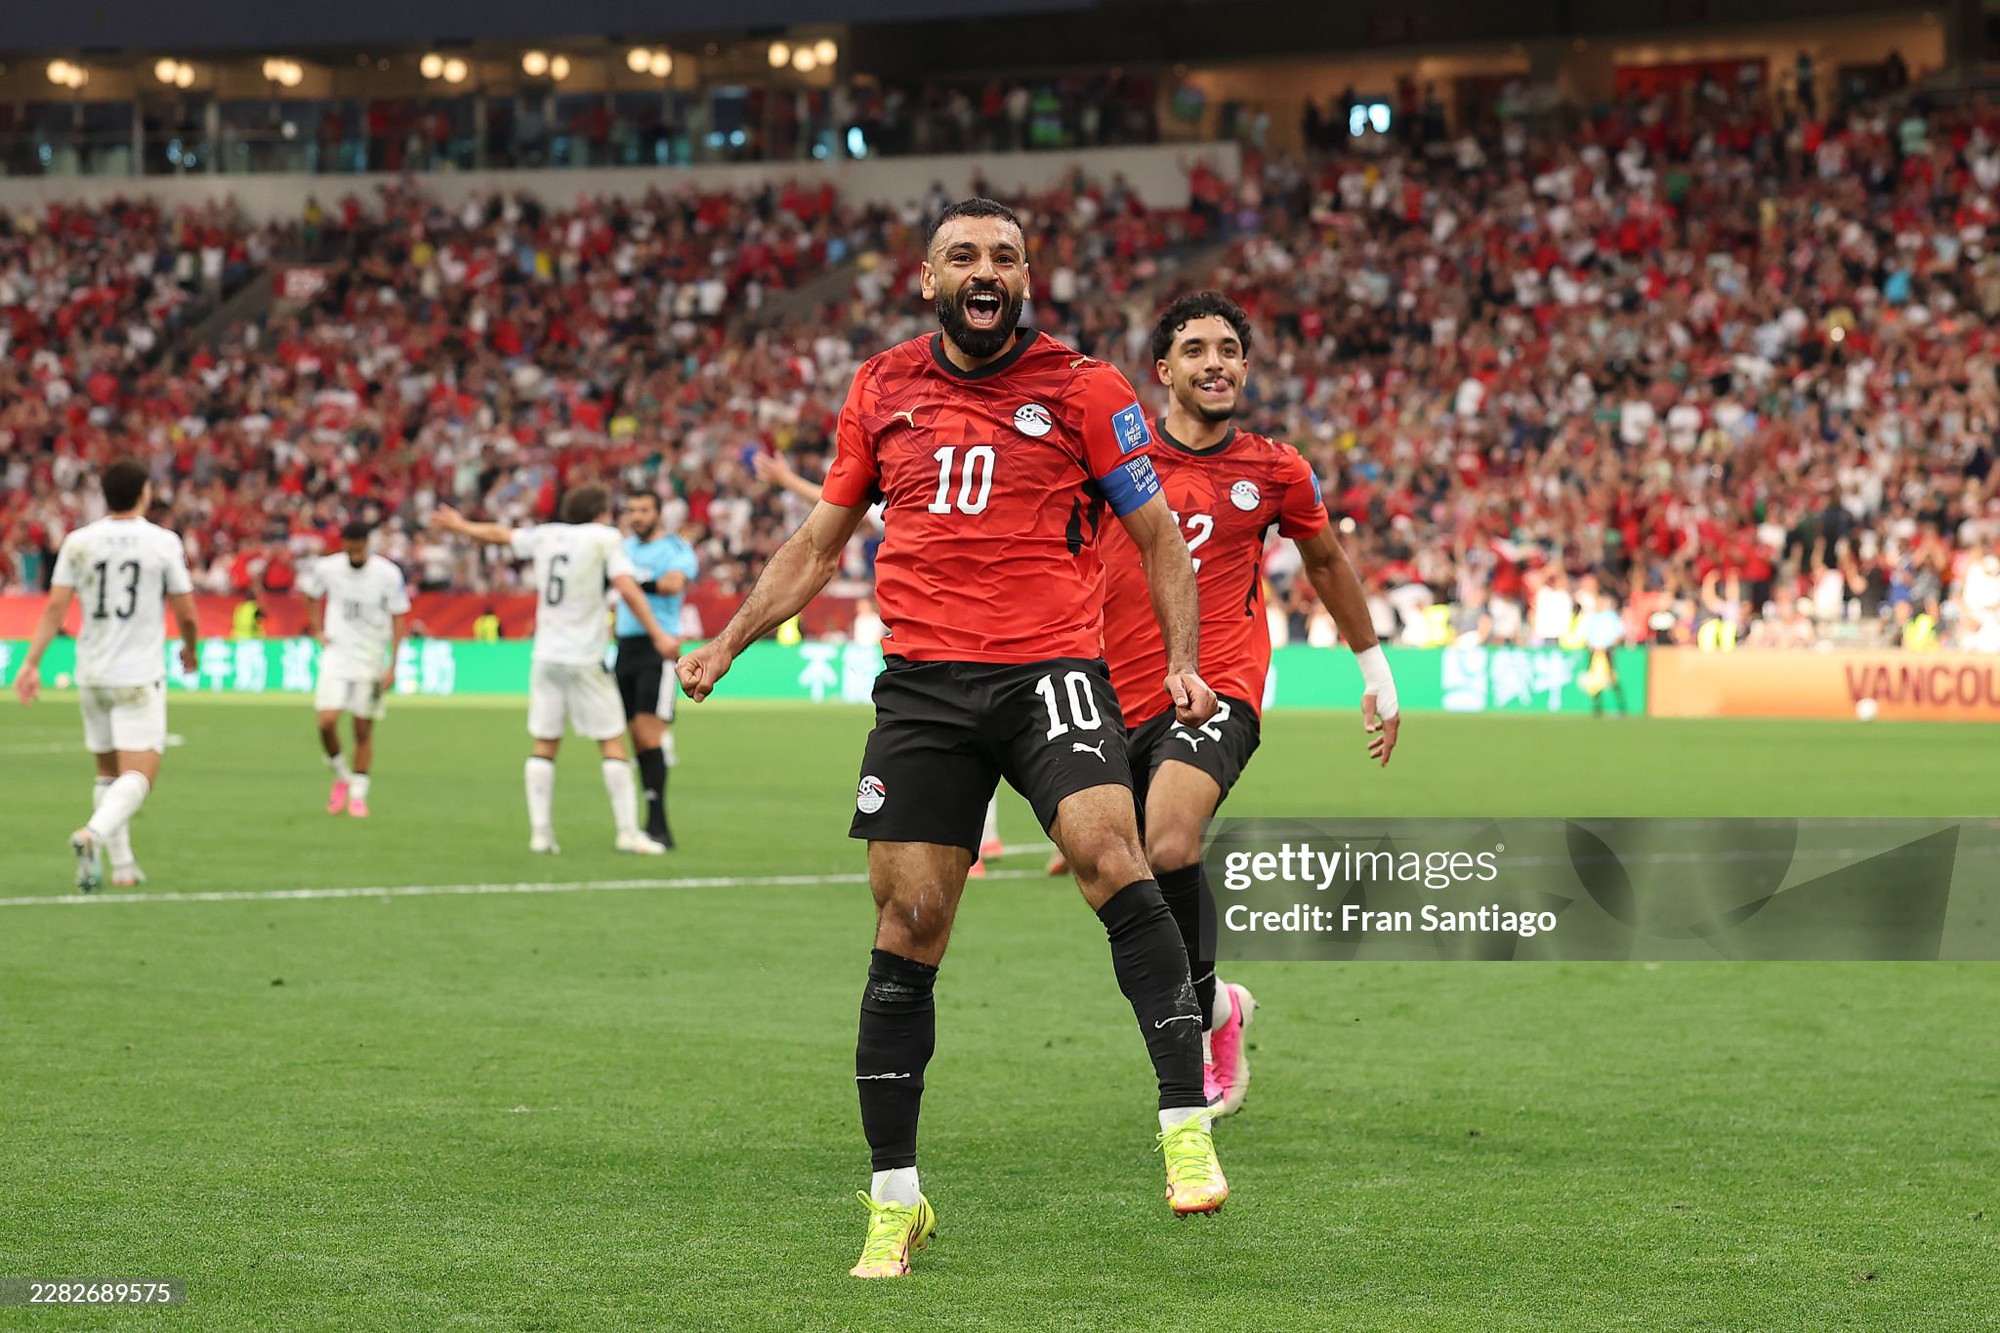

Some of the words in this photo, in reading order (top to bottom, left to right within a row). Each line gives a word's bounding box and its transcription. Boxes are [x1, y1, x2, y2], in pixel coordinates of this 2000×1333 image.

[928, 446, 996, 514] 10
[93, 560, 141, 620] 13
[546, 554, 568, 607] 6
[1034, 671, 1102, 742] 10
